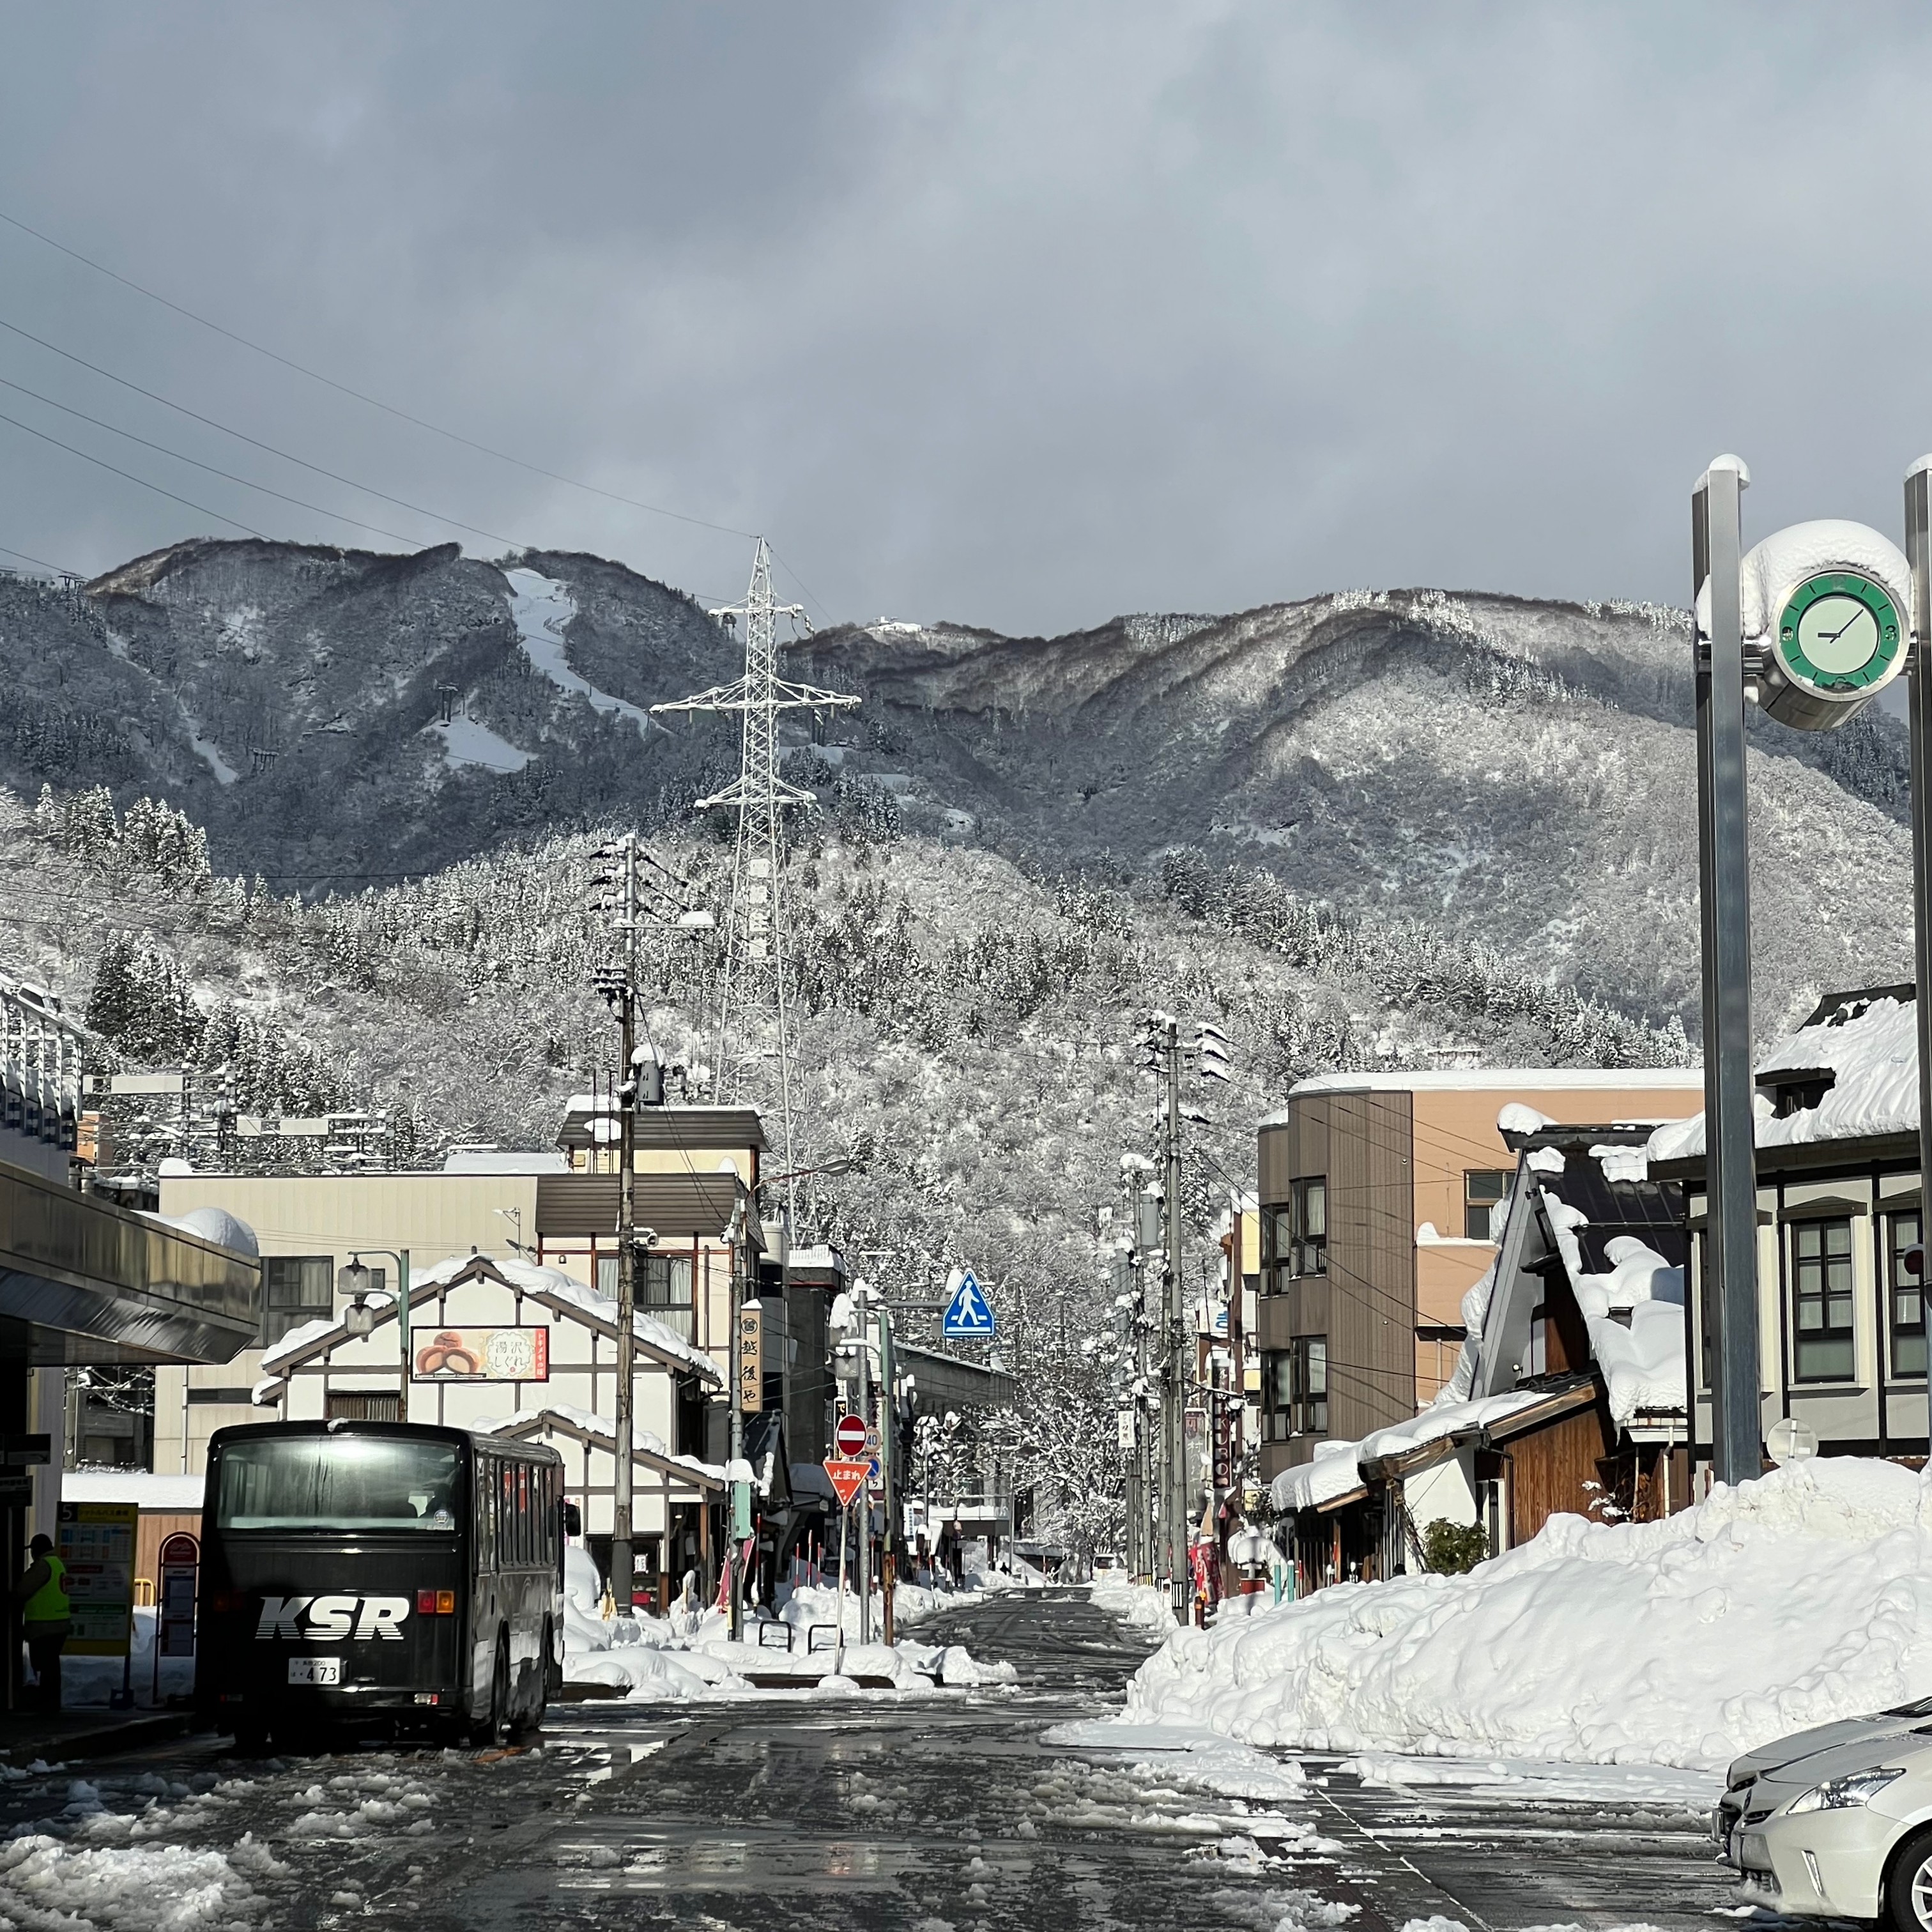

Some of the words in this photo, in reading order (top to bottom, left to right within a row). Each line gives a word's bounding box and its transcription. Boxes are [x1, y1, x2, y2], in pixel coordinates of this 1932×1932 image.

[1885, 625, 1896, 640] 3
[495, 1342, 522, 1353] 湯沢
[495, 1356, 523, 1367] しぐれ
[741, 1340, 758, 1403] 越後や
[867, 1435, 877, 1446] 40
[832, 1469, 861, 1480] 止まれ
[62, 1503, 73, 1520] 5
[255, 1596, 410, 1641] KSR
